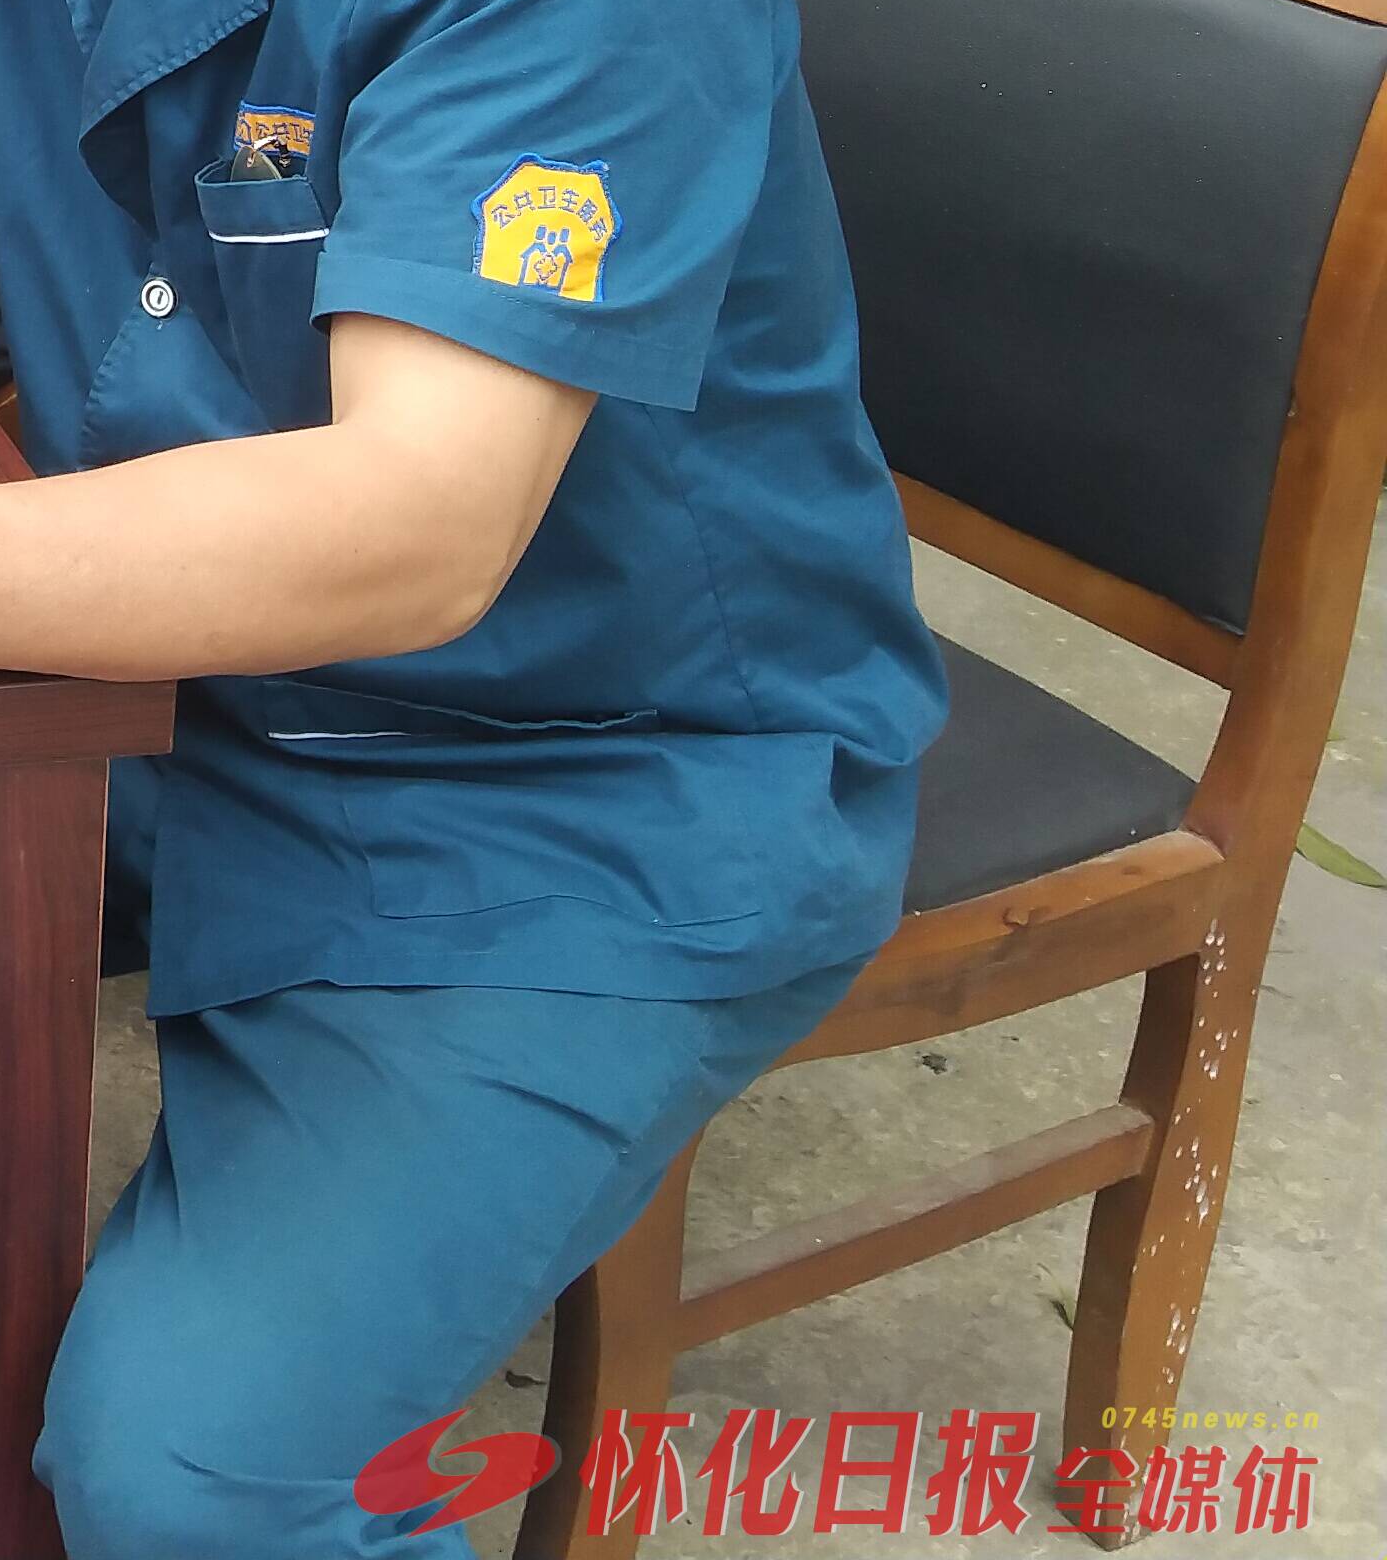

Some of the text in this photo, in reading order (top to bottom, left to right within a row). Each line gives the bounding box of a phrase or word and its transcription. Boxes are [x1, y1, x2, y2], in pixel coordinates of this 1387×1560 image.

[491, 186, 608, 242] 公共卫生服务
